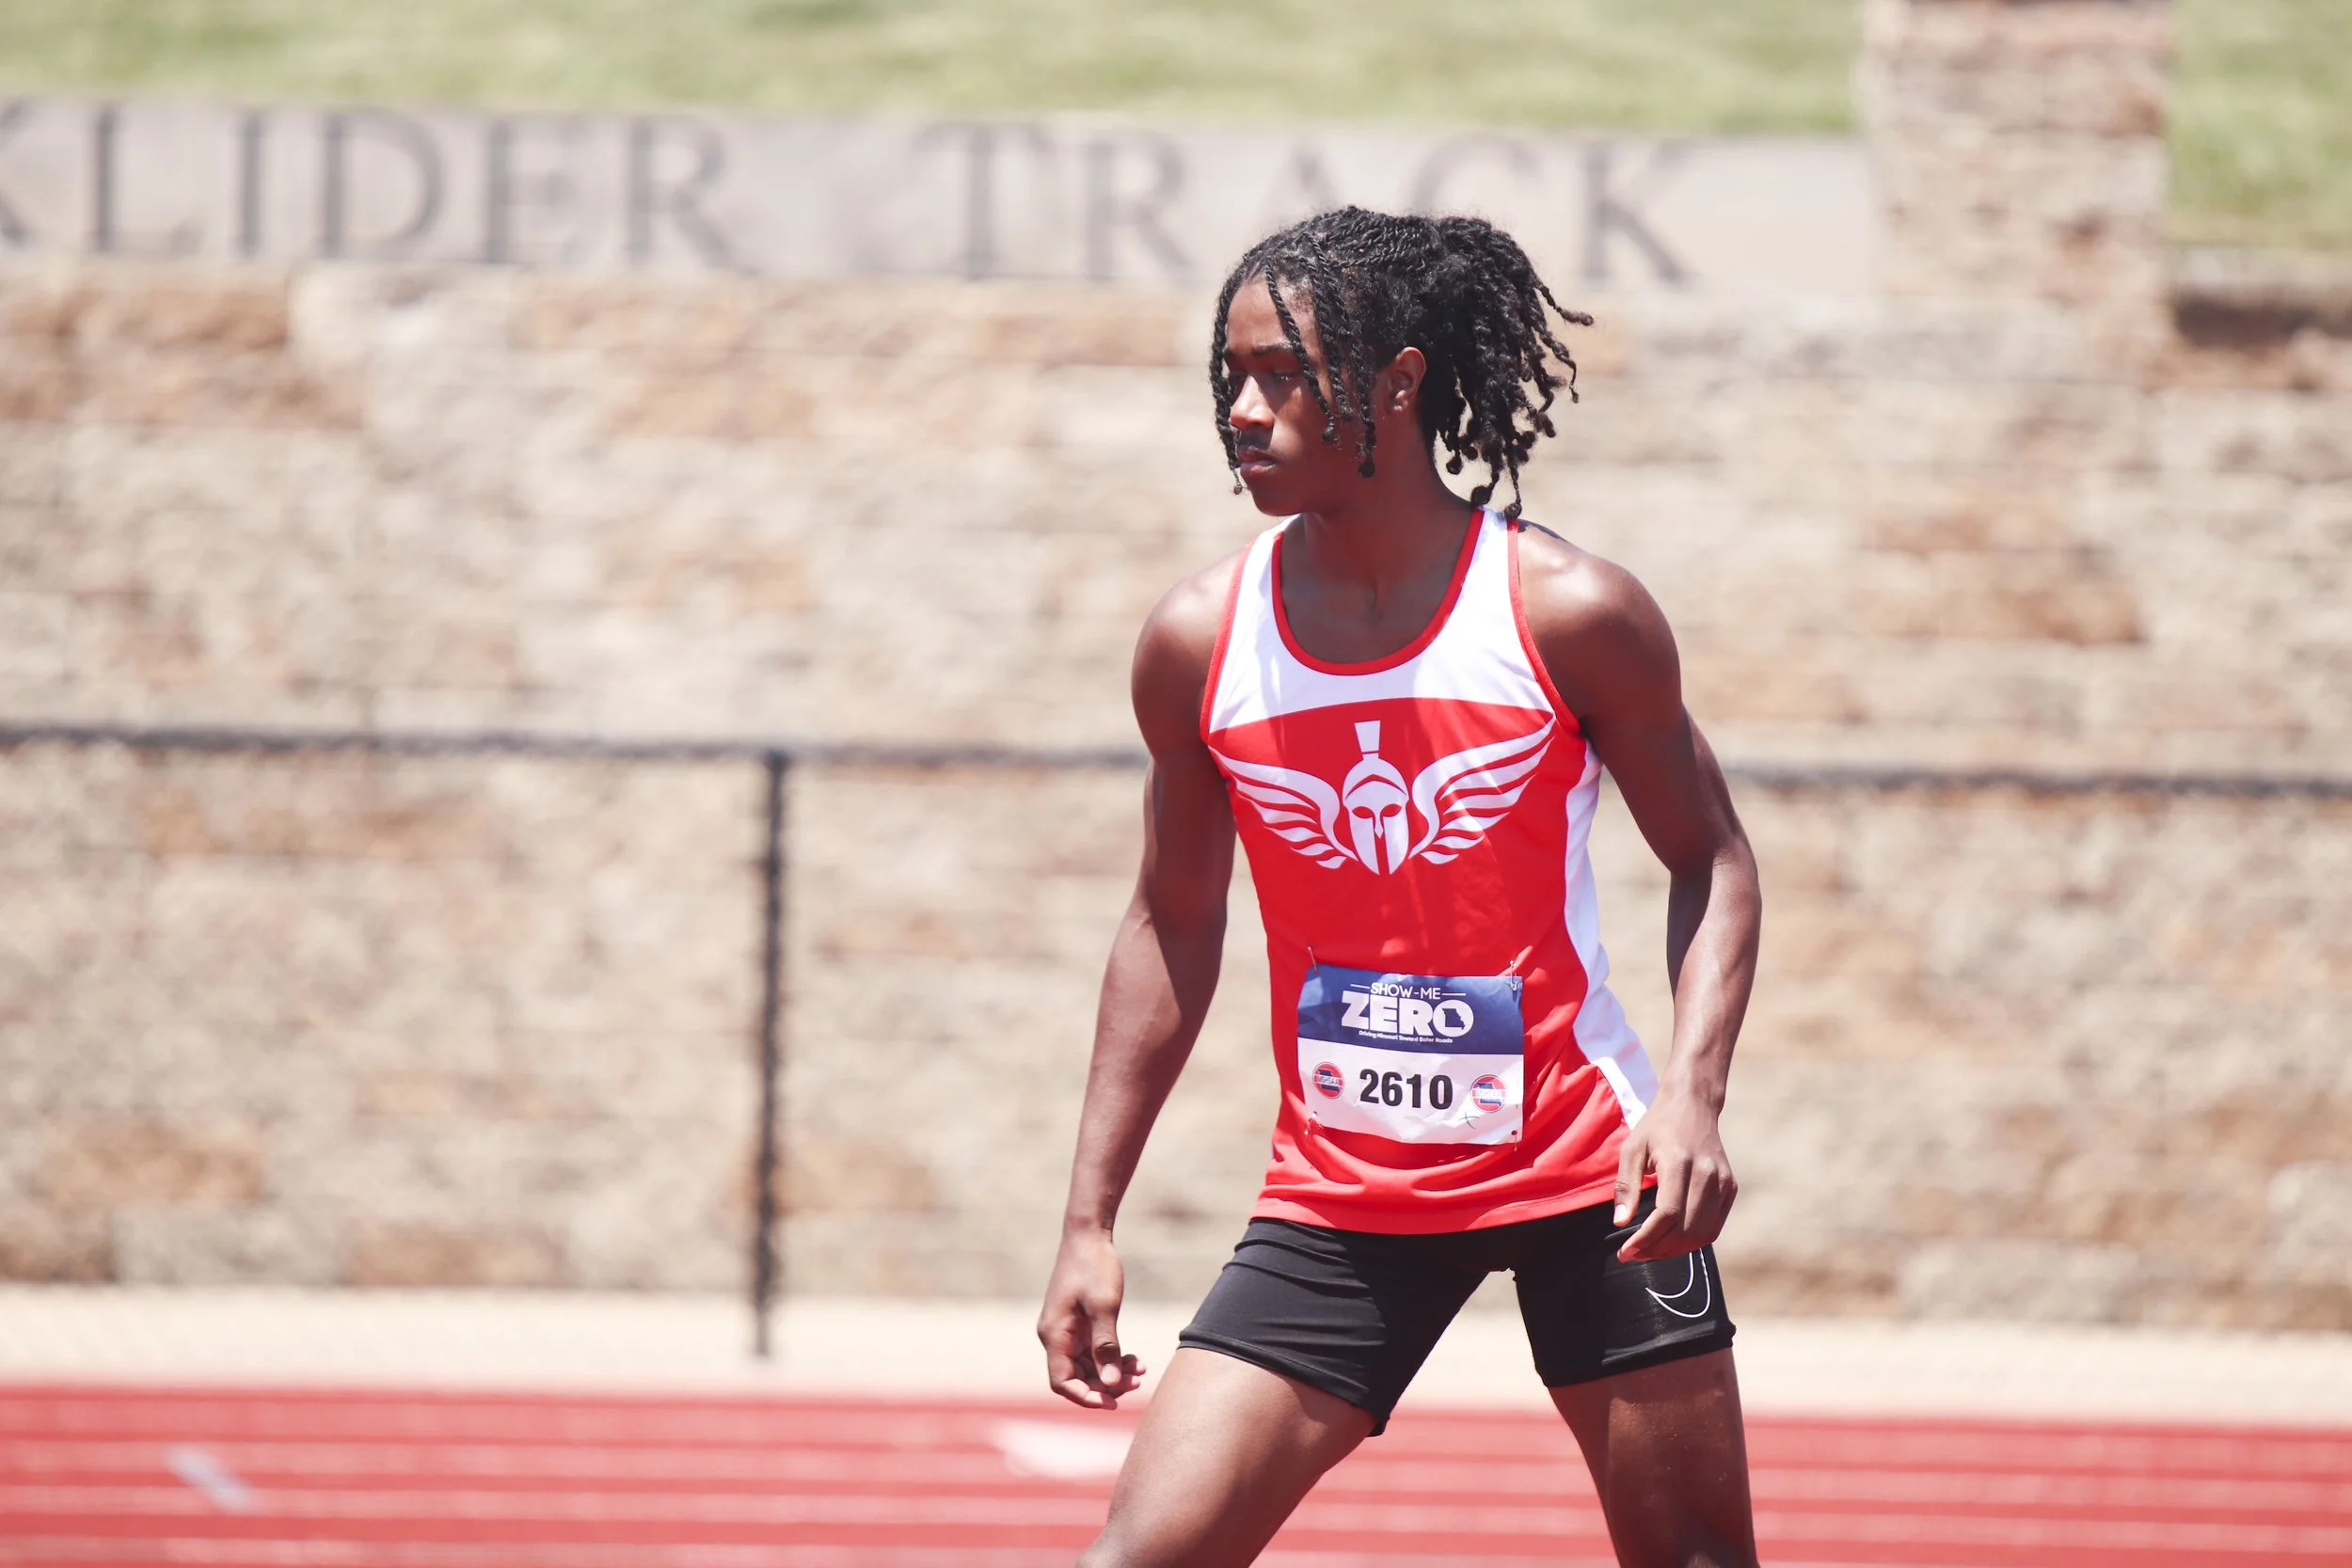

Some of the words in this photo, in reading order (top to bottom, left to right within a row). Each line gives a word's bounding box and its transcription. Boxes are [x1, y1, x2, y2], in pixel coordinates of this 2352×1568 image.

[1371, 982, 1441, 1000] SHOW-ME
[1342, 990, 1474, 1037] ZERO
[1359, 1030, 1376, 1038] Driving
[1359, 1069, 1453, 1111] 2610
